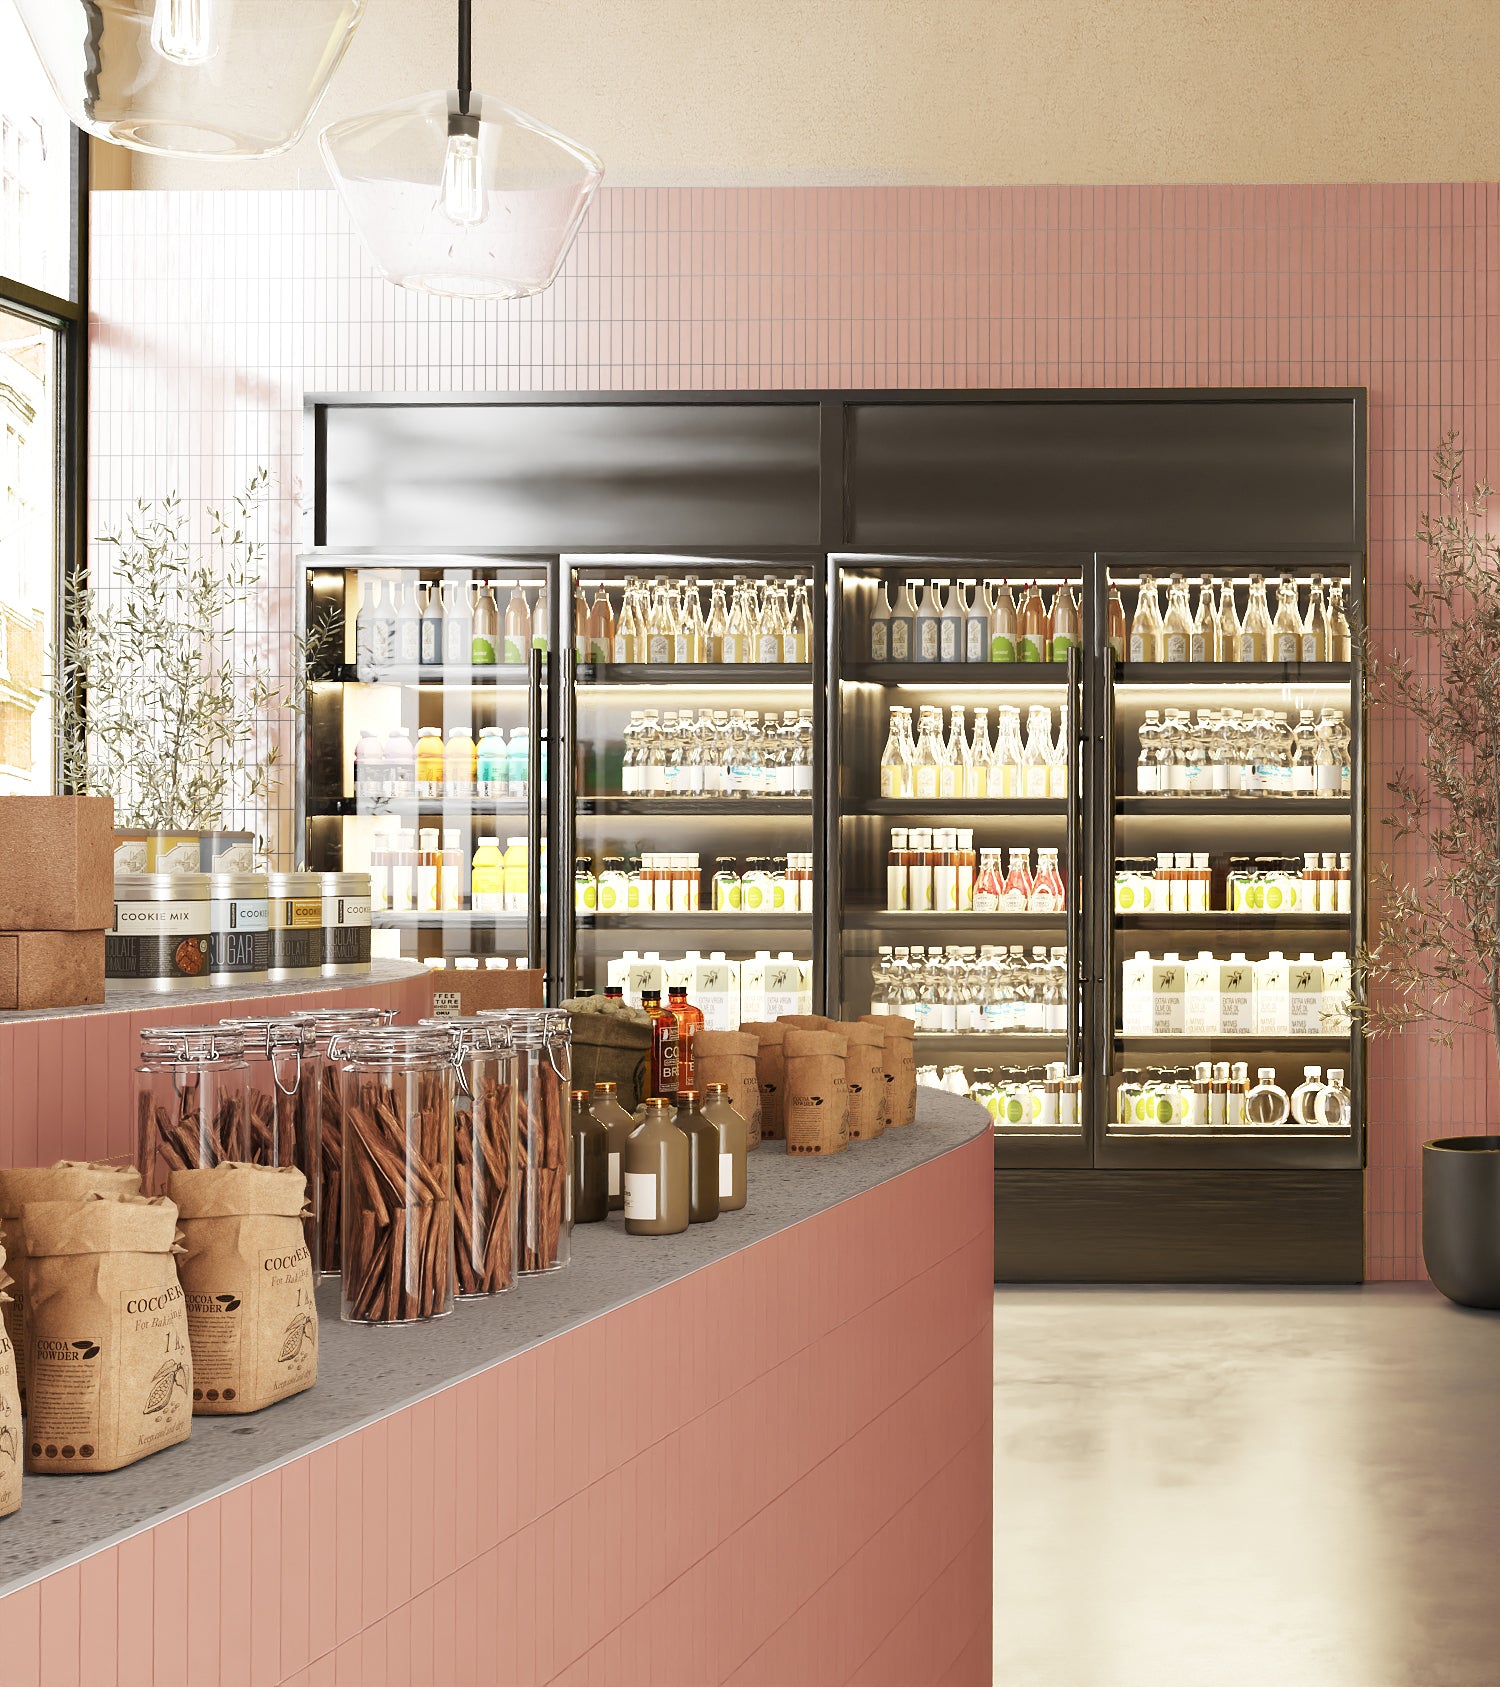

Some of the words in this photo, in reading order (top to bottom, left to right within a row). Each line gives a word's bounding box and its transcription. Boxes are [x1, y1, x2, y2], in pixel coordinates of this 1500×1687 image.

[121, 912, 166, 921] COOKIE
[169, 912, 190, 920] MIX
[663, 1046, 680, 1059] CO
[663, 1067, 680, 1078] BR
[185, 1295, 213, 1304] COCOA
[186, 1304, 222, 1313] POWDER
[37, 1340, 69, 1351] COCOA
[164, 1331, 171, 1354] 1
[37, 1350, 79, 1361] POWDER
